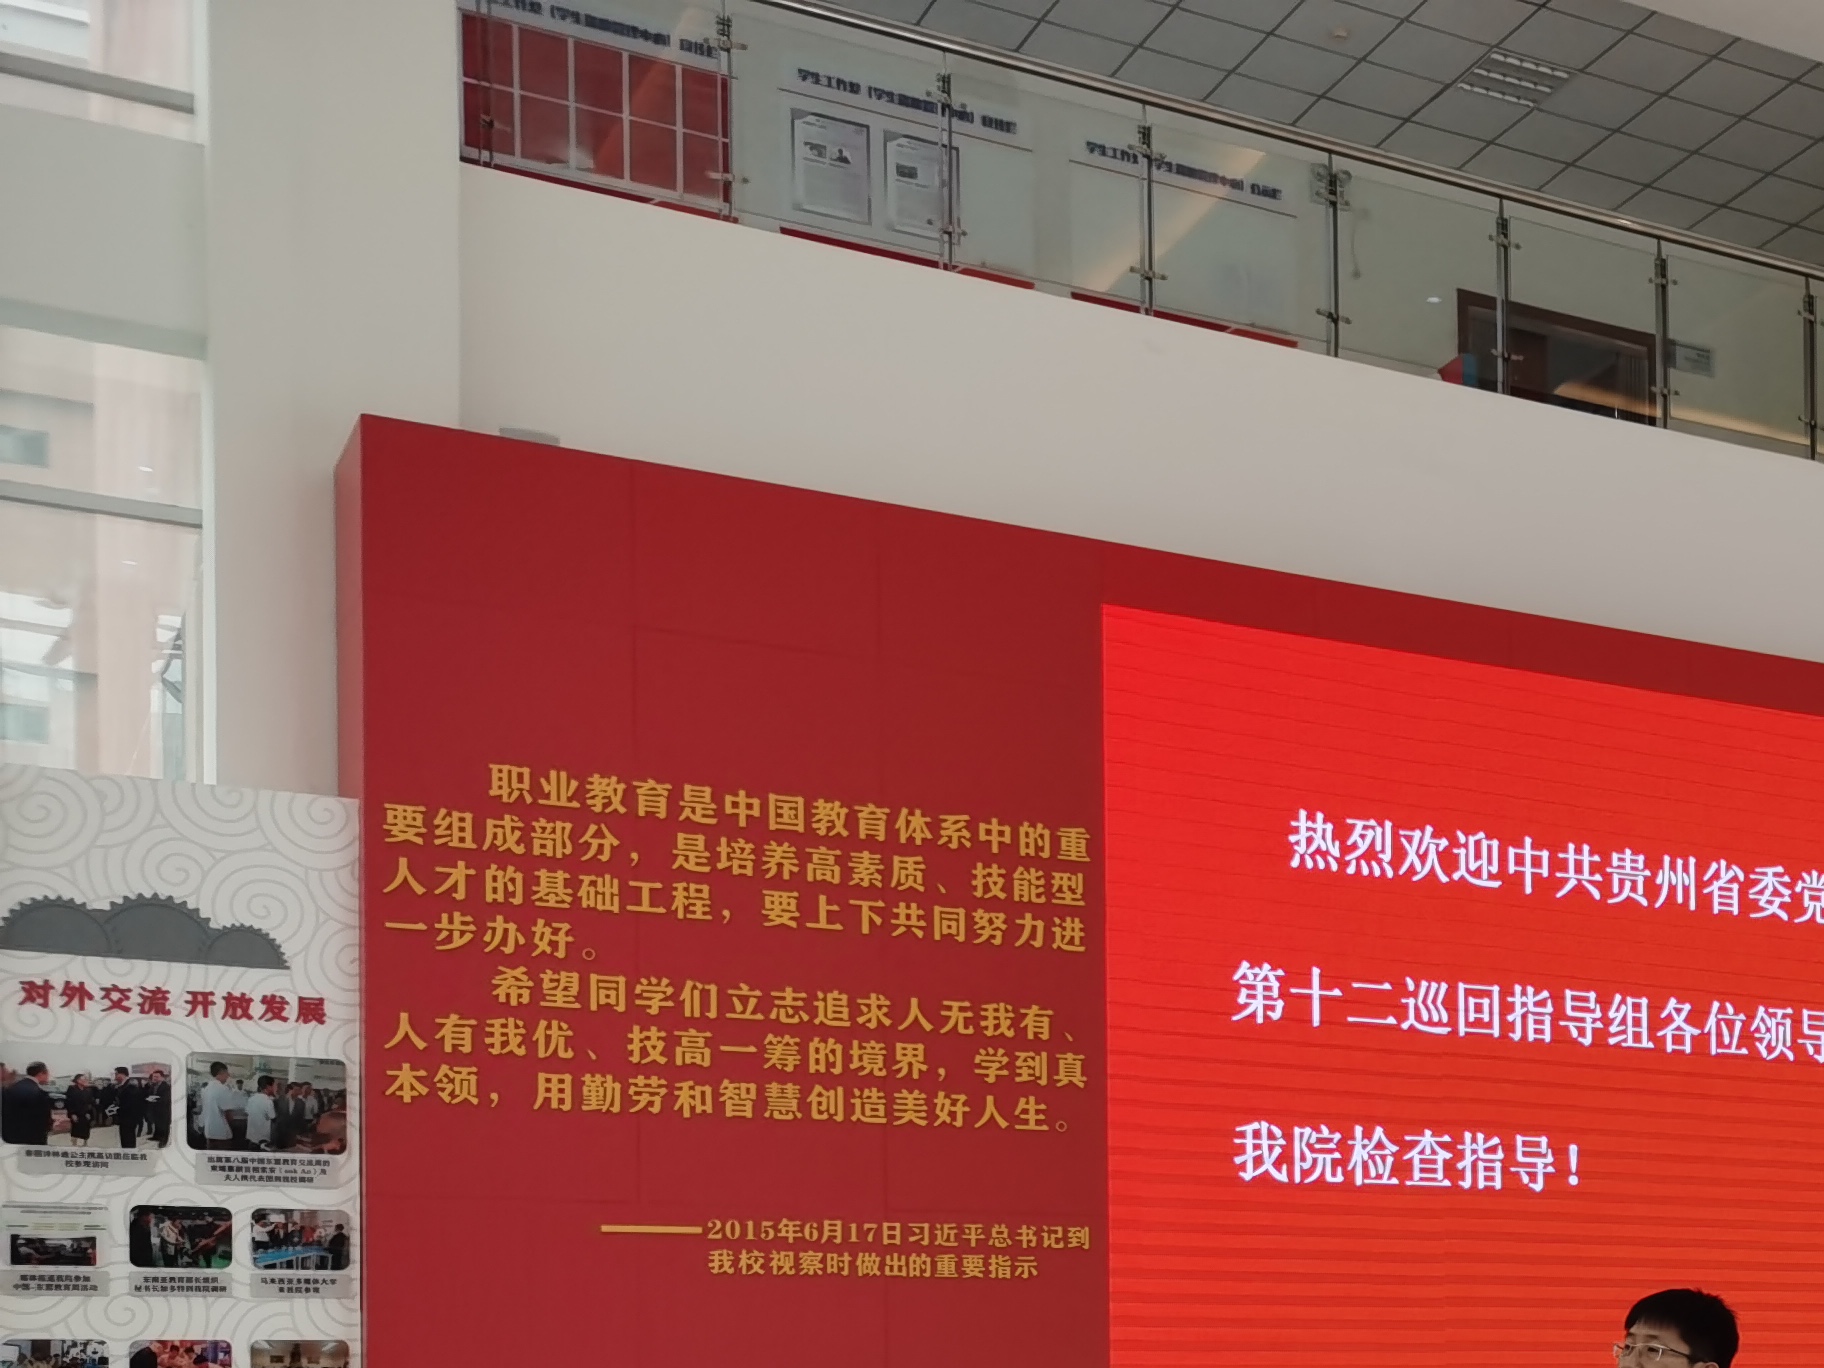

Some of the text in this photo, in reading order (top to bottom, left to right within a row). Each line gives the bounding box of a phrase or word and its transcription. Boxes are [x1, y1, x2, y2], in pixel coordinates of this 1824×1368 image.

[488, 762, 1091, 864] 职业教育是中国教育体系中的重
[382, 804, 1086, 908] 要组成部分，是培养高素质、技能型
[382, 857, 1087, 953] 人才的基础工程，要上下共同努力进
[385, 911, 598, 961] 一步办好。
[18, 979, 327, 1025] 对外交流 开放发展
[490, 965, 1080, 1042] 希望同学们立志追求人无我有、
[384, 1010, 1088, 1089] 人有我优、技高一筹的境界，学到真
[384, 1063, 1070, 1133] 本领，用勤劳和智慧创造美好人生。
[1231, 1120, 1581, 1192] 我院检查指导！
[707, 1250, 1039, 1280] 我校视察时做出的重要指示
